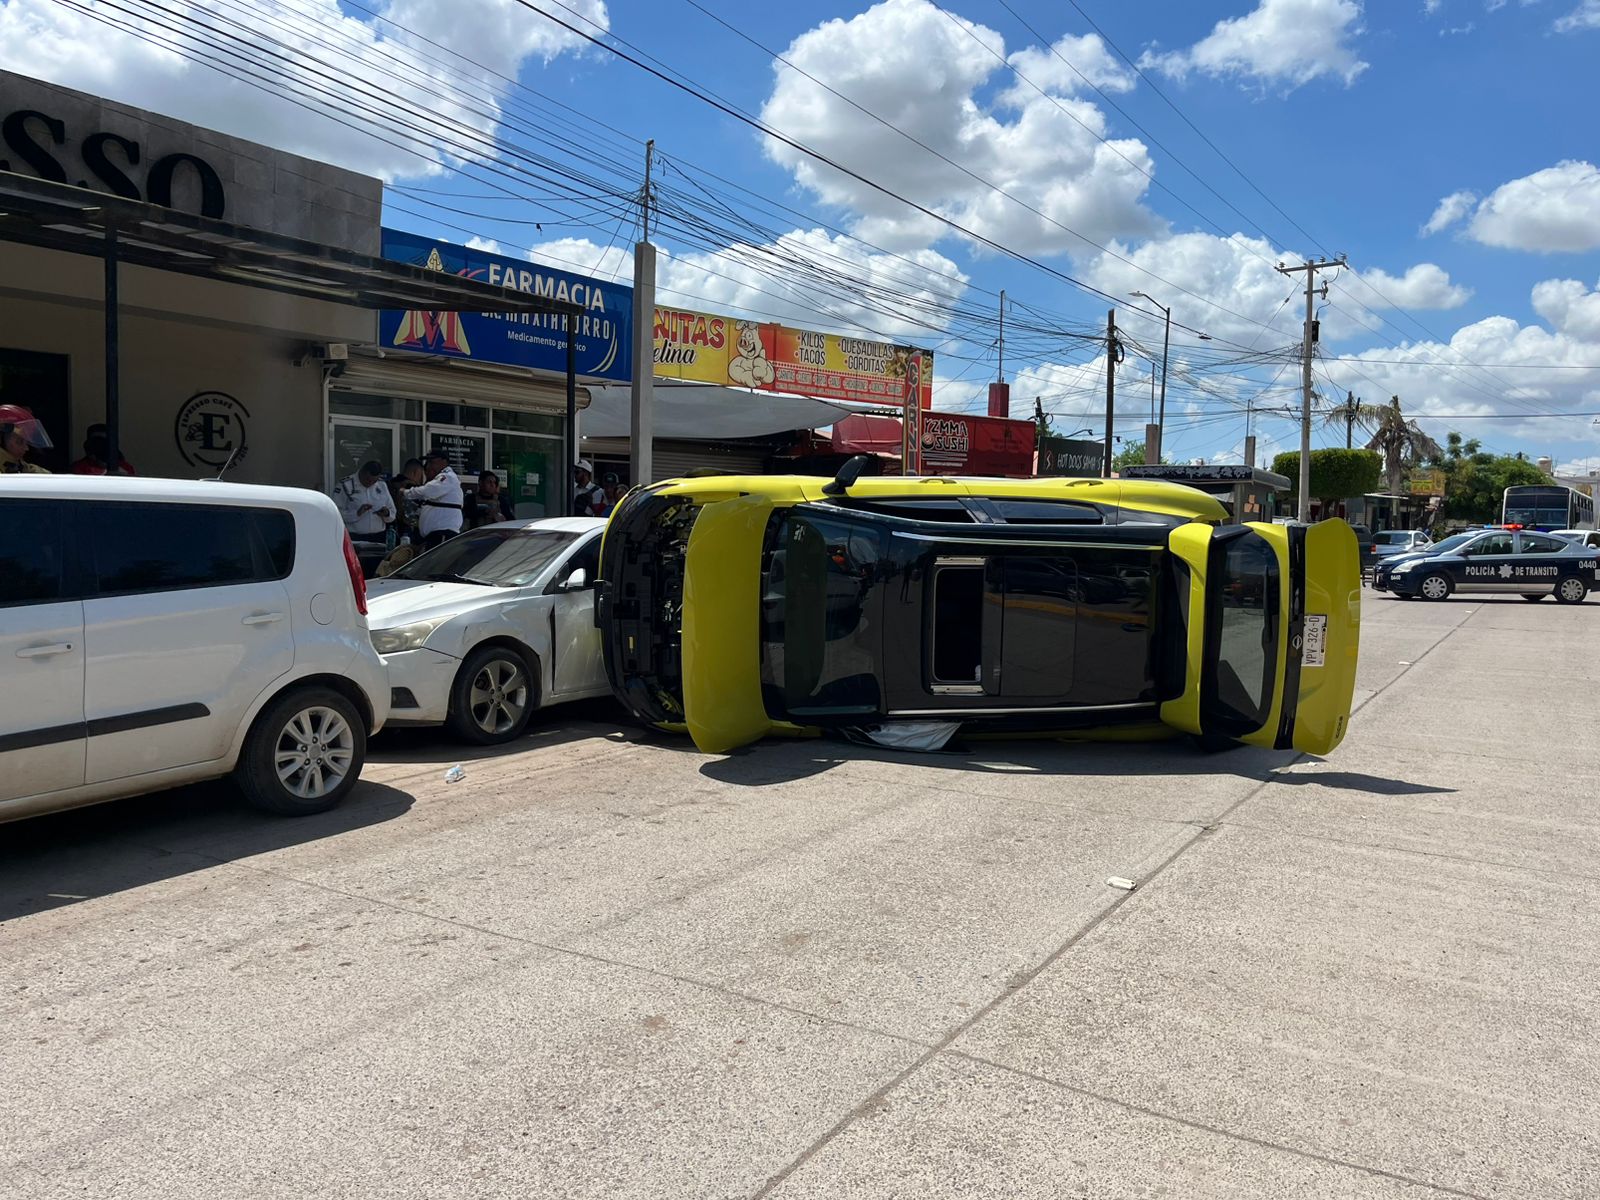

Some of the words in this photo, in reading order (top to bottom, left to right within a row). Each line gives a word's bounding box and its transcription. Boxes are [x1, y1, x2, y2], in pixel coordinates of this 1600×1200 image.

[489, 263, 606, 313] FARMACIA
[507, 330, 557, 347] Medicamento
[800, 331, 825, 350] KILOS
[799, 347, 826, 366] TACOS
[841, 338, 895, 361] QUESADILLAS
[847, 355, 886, 374] GORDITAS
[439, 436, 474, 447] FARMACIA
[936, 436, 969, 451] SUSHI
[1057, 453, 1069, 469] HOT
[1069, 453, 1083, 471] DOGS
[1515, 566, 1525, 576] DE
[1525, 566, 1558, 576] TRANSITO
[1578, 560, 1597, 569] 0440
